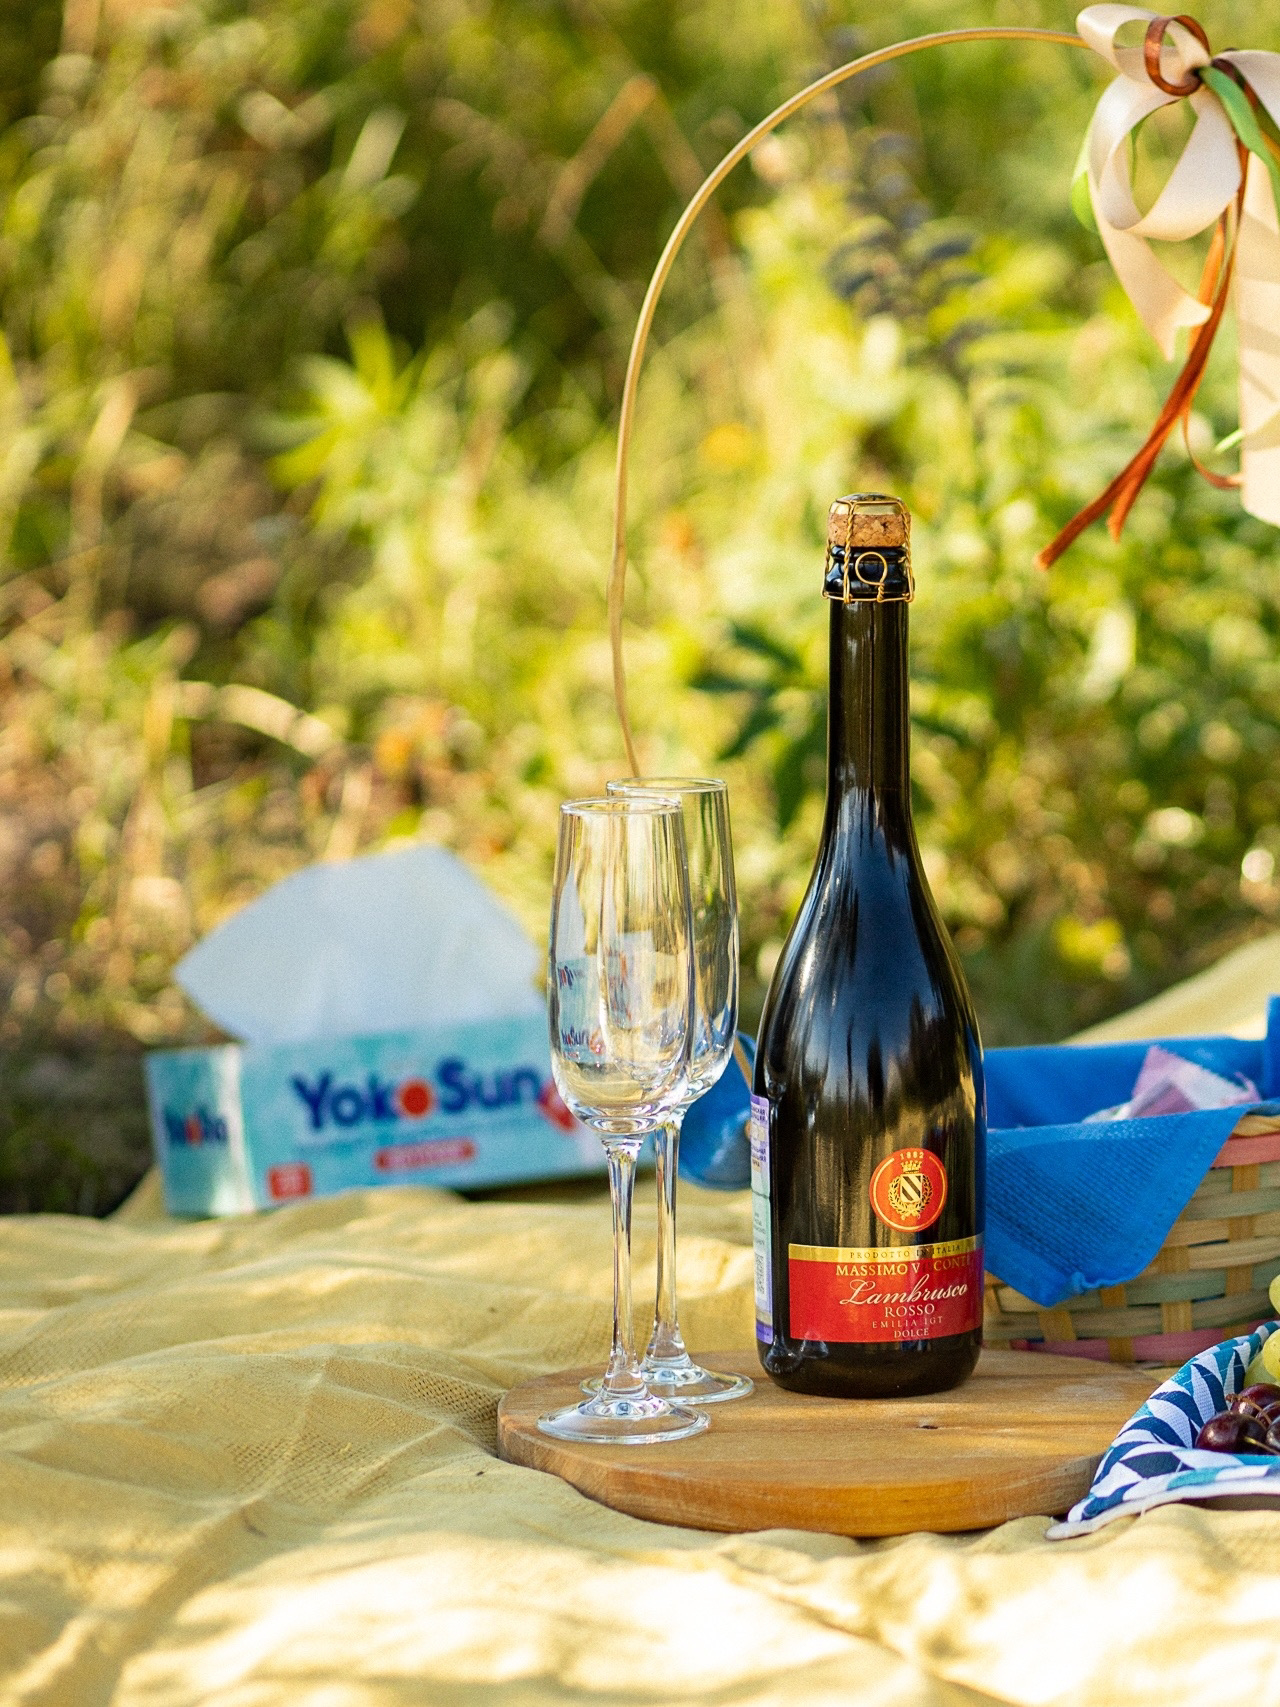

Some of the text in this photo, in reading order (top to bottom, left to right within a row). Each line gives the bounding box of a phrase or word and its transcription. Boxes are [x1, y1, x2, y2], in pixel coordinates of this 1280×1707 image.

[289, 1055, 541, 1129] YokoSun
[850, 1244, 961, 1259] PRODOTTO IN ITALIA
[835, 1263, 908, 1277] MASSIMO
[839, 1273, 968, 1305] Lambrusco
[884, 1303, 935, 1318] ROSSO
[872, 1316, 943, 1329] EMILIA IGT
[894, 1328, 929, 1339] DOLCE
